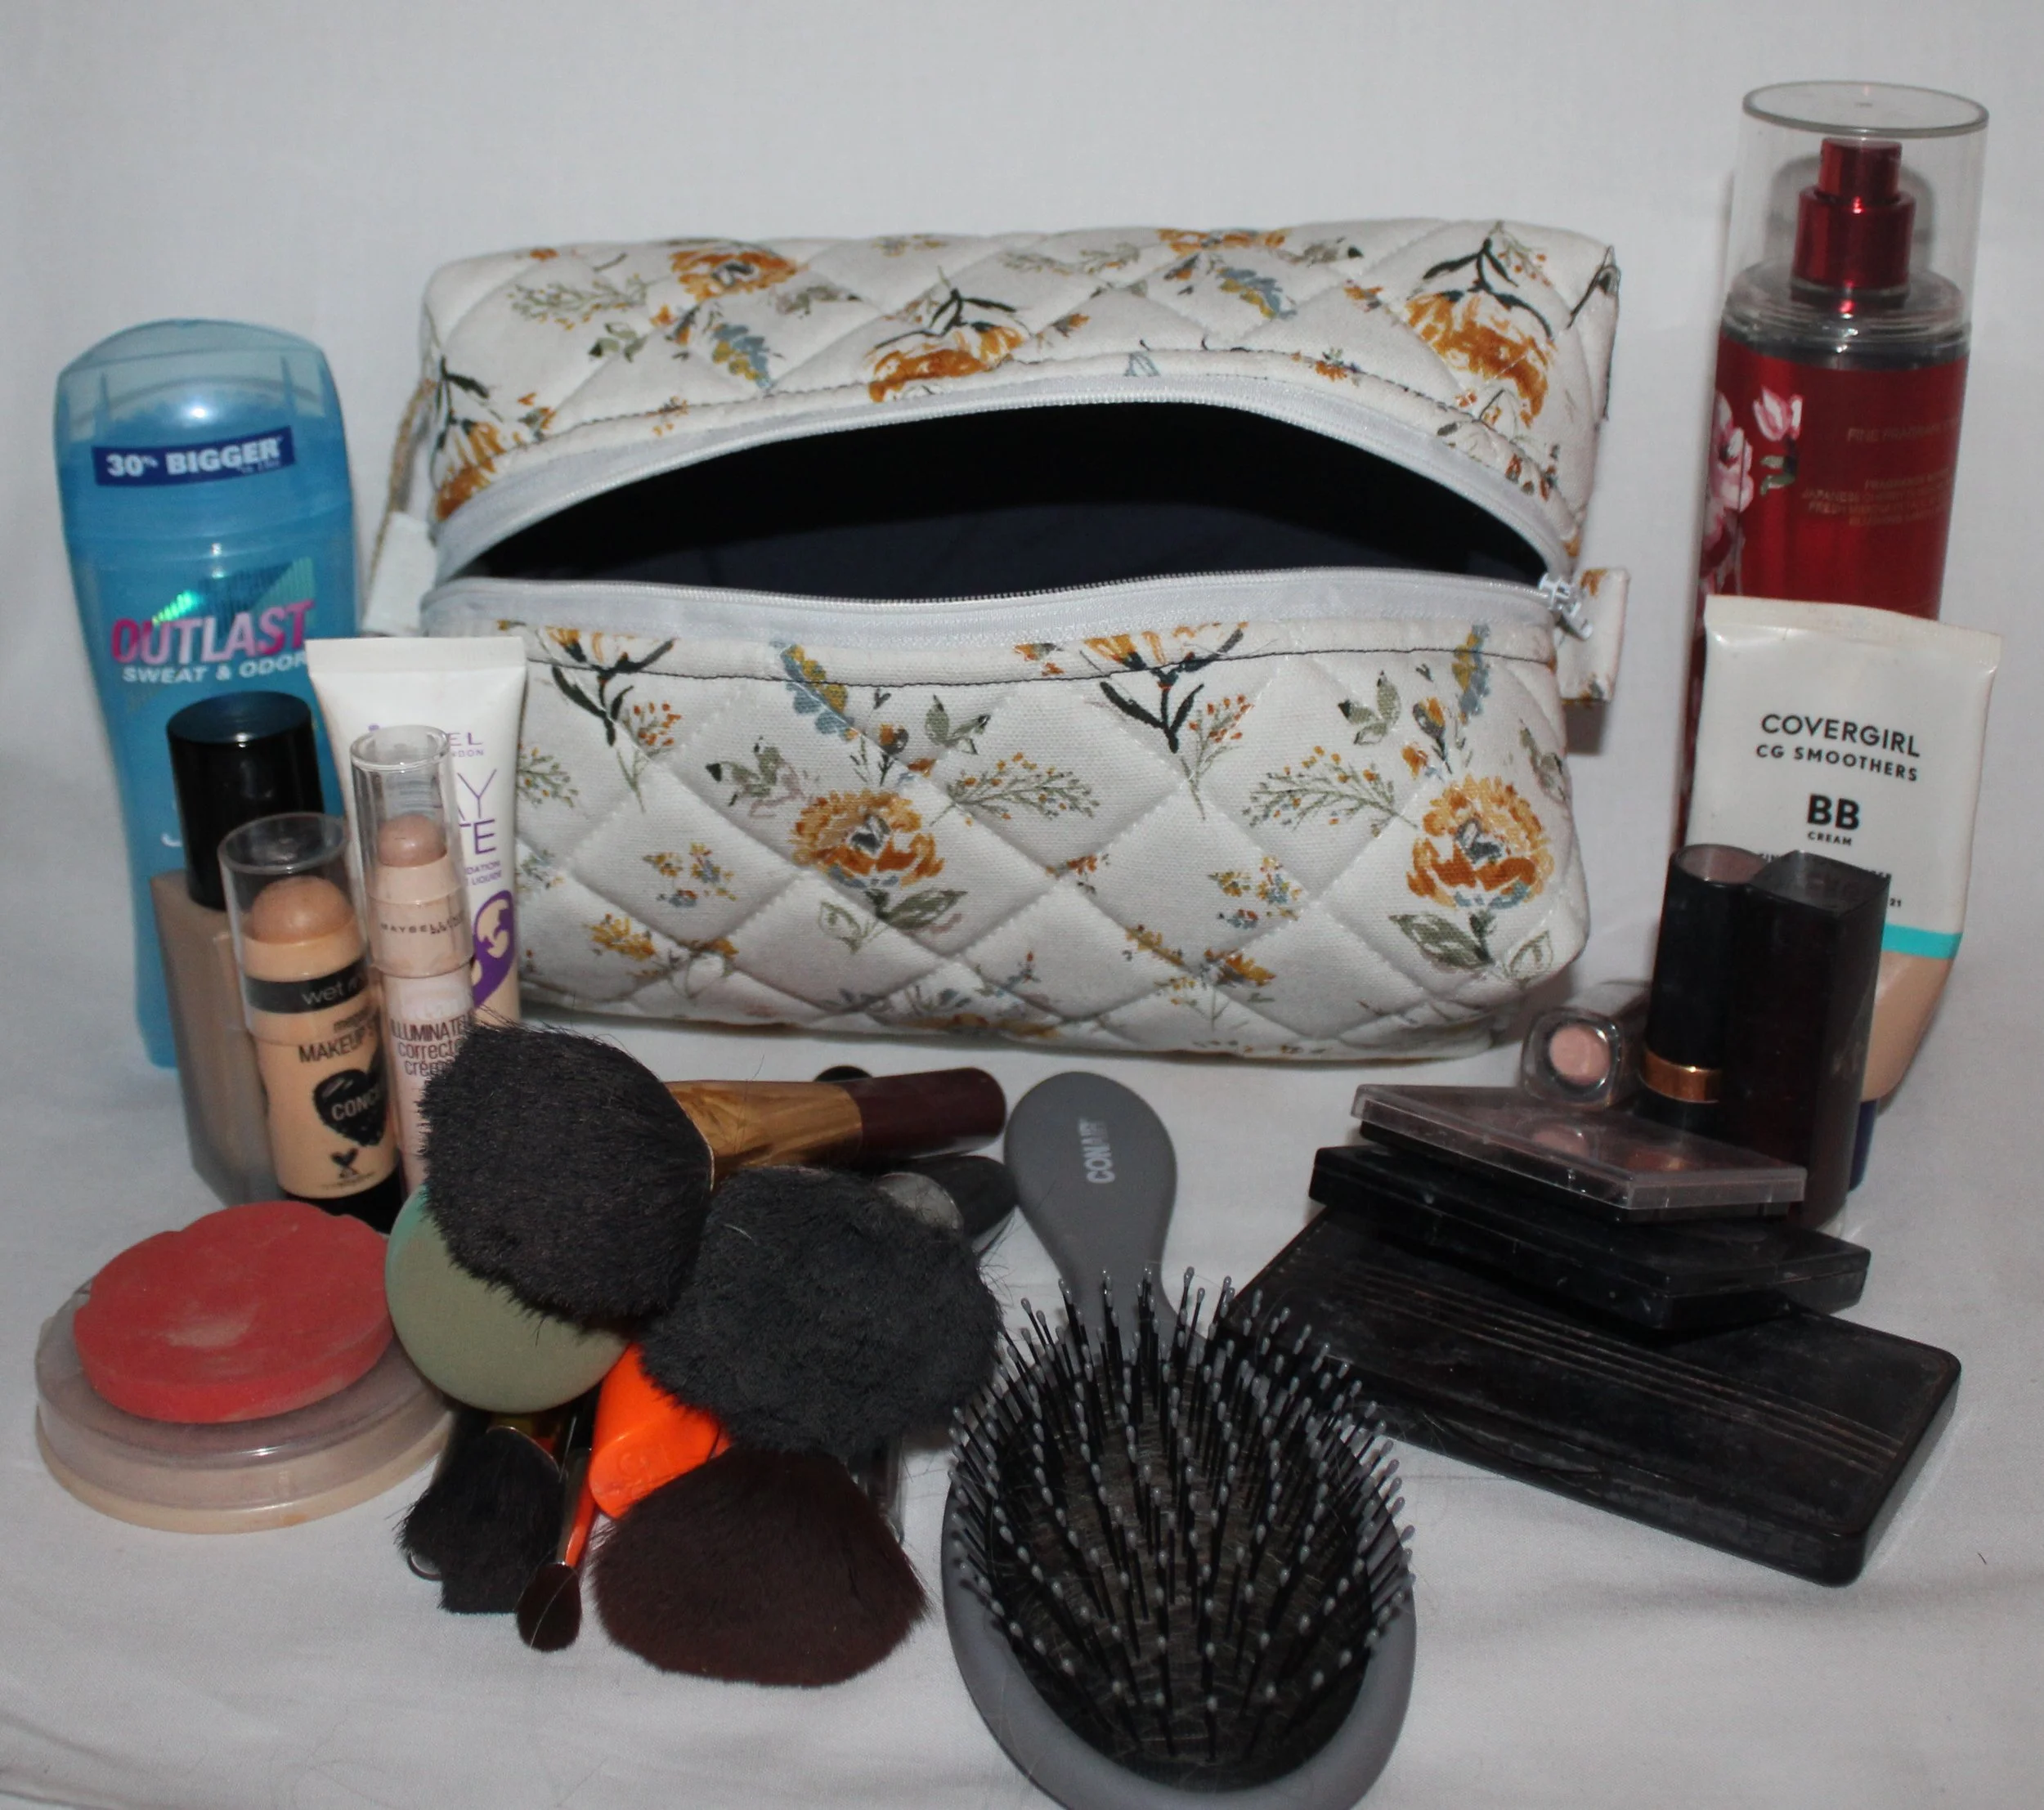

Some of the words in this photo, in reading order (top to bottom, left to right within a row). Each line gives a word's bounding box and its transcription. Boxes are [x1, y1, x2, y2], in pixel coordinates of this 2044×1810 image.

[106, 453, 159, 477] 30%
[165, 437, 280, 476] BIGGER
[111, 599, 315, 665] OUTLAST
[123, 665, 208, 684] SWEAT
[216, 663, 232, 681] &
[1760, 714, 1921, 758] COVERGIRL
[1756, 744, 1785, 759] CG
[1794, 746, 1918, 782] SMOOTHERS
[1807, 794, 1860, 831] BB
[1808, 831, 1853, 846] CREAM
[301, 981, 336, 1006] wet
